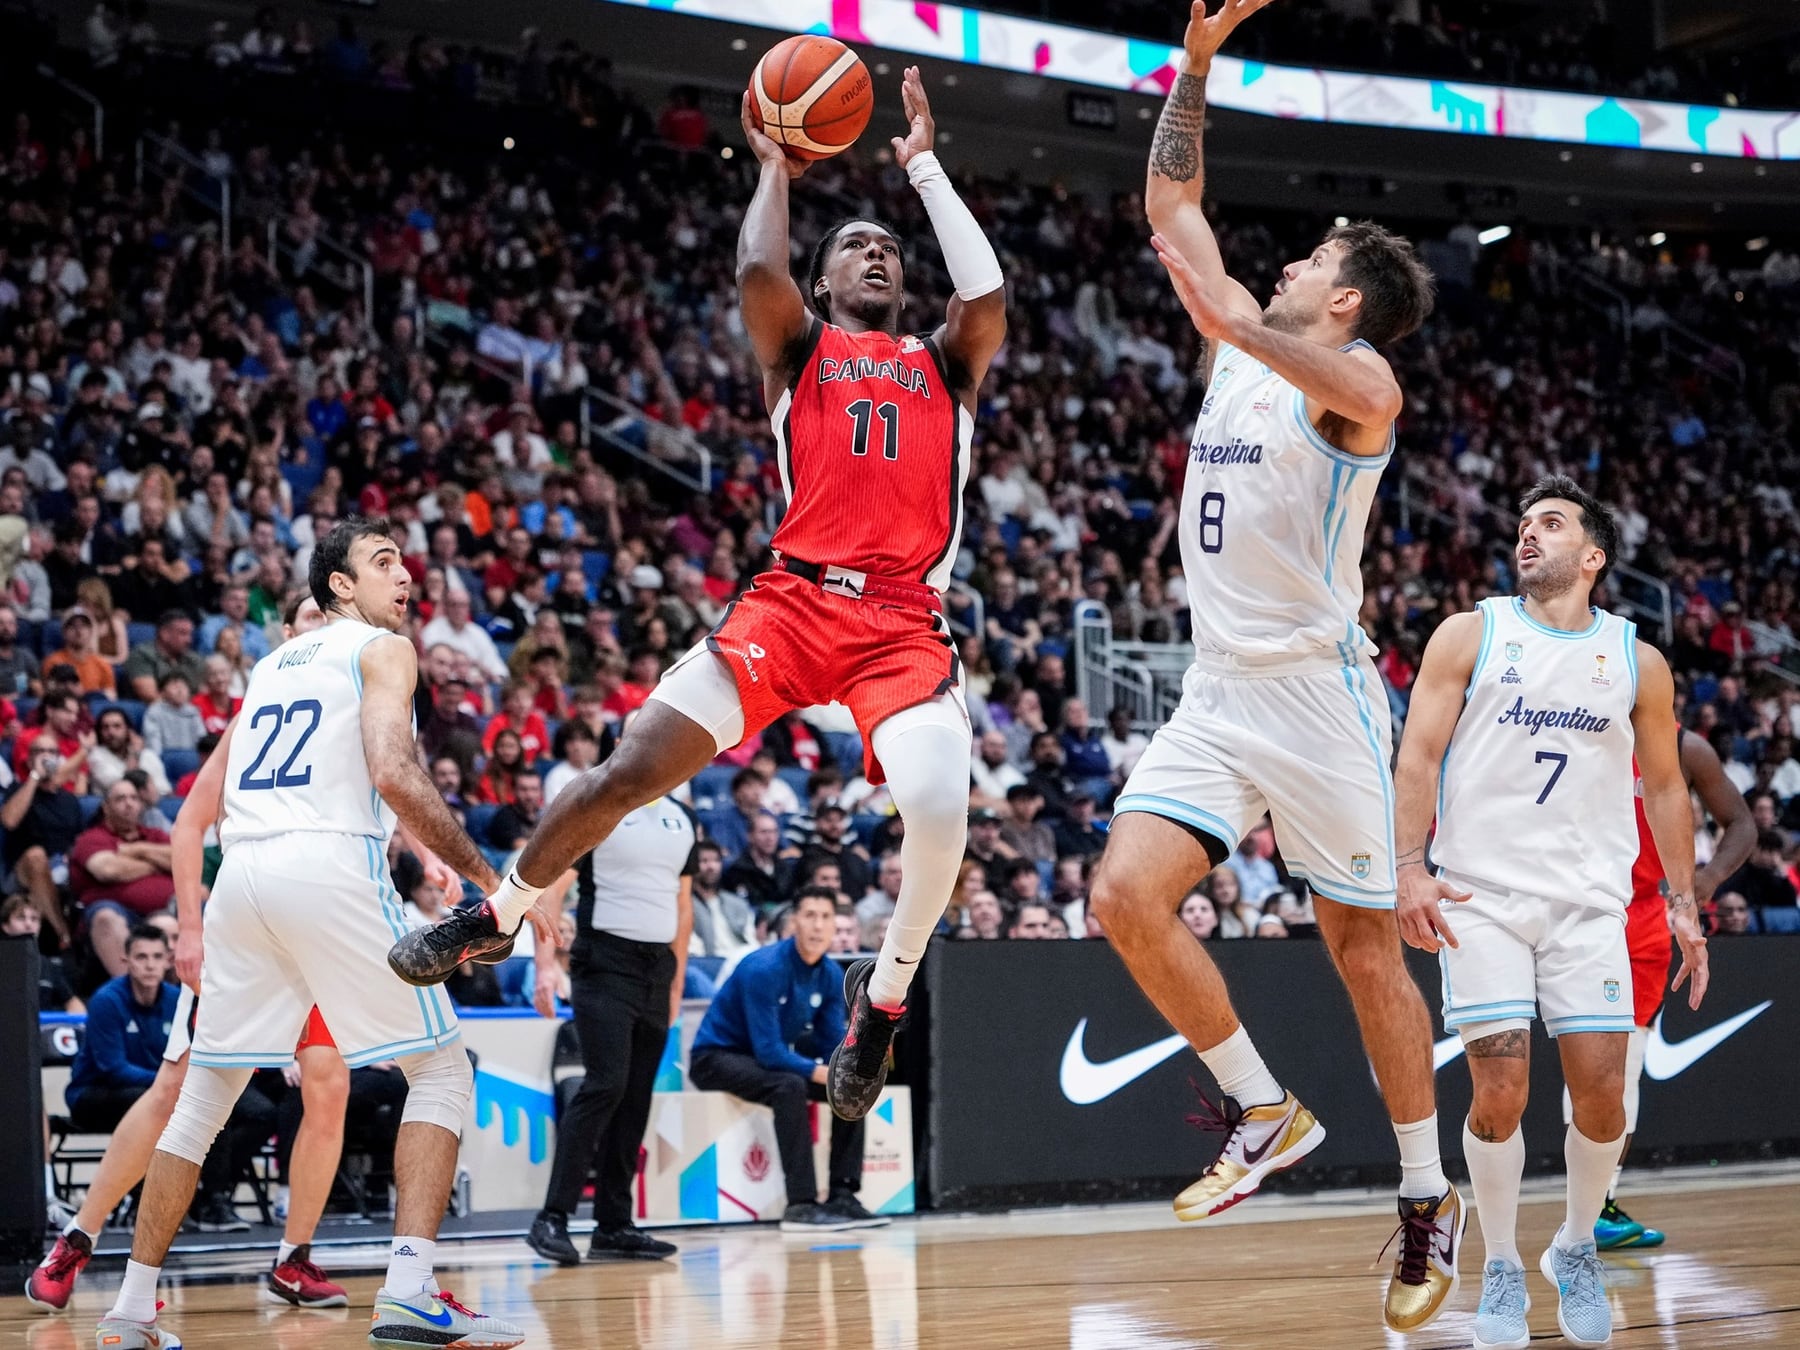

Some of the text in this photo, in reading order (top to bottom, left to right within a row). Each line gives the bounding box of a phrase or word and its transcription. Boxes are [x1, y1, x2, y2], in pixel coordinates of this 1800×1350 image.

[819, 356, 931, 399] CANADA
[845, 399, 899, 460] 11
[1200, 491, 1225, 554] 8
[1501, 676, 1523, 685] PEAK
[1498, 696, 1611, 737] Argentina
[238, 699, 323, 791] 22
[1534, 750, 1569, 805] 7
[53, 1026, 79, 1056] G
